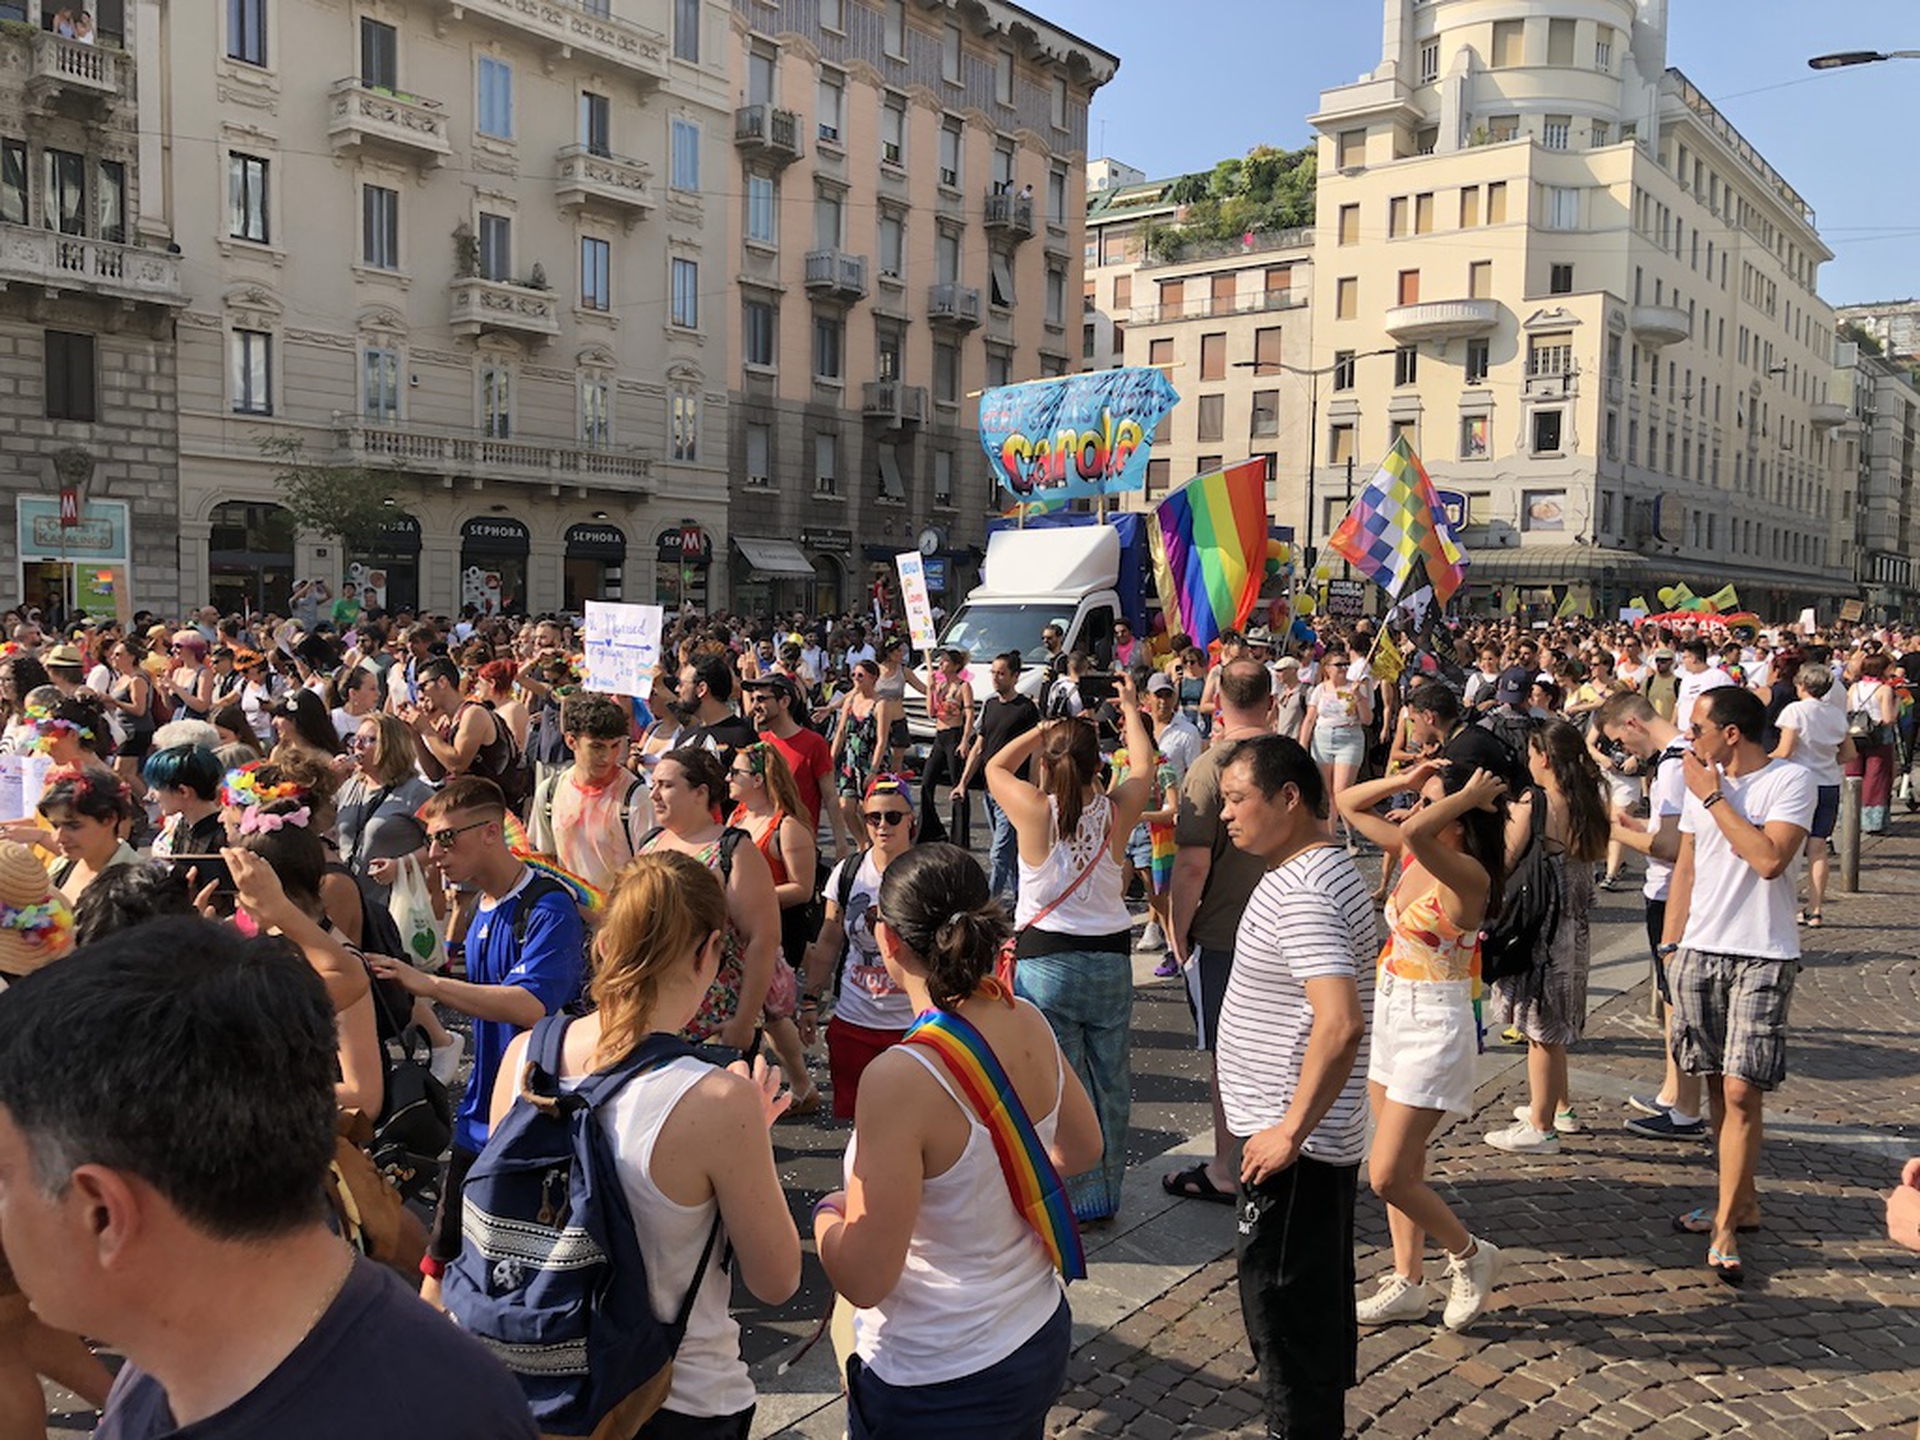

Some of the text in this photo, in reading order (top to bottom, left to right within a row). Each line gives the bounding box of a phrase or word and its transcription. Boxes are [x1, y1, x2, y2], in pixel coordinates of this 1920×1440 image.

[62, 495, 77, 518] M
[470, 524, 524, 537] SEPHORA
[573, 531, 620, 543] SEPHORA
[683, 532, 699, 550] M
[851, 962, 895, 991] Supre
